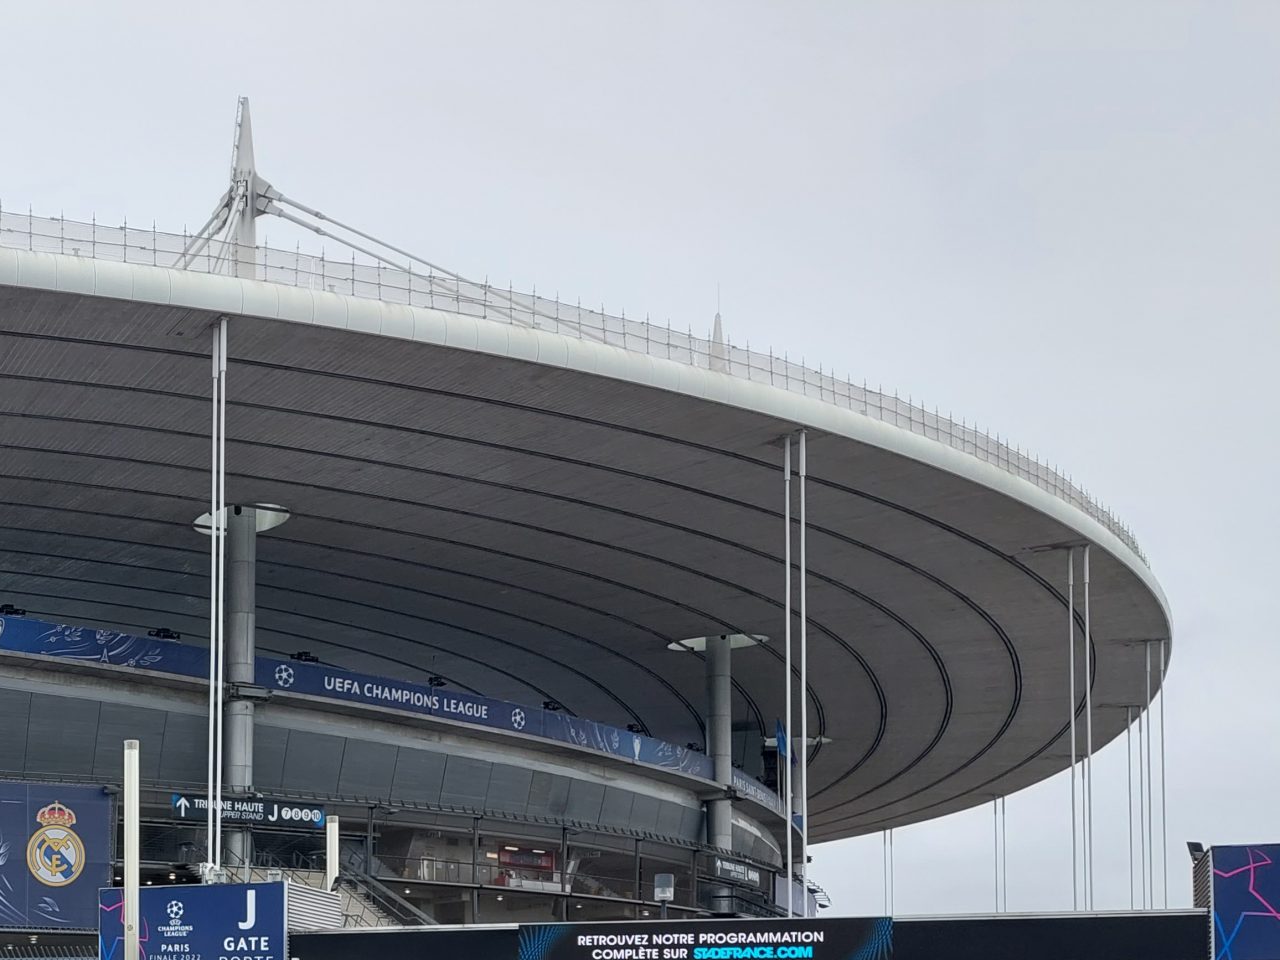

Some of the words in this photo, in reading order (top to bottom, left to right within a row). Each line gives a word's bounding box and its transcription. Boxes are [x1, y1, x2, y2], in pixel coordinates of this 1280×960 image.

[324, 676, 360, 695] UEFA
[364, 683, 439, 709] CHAMPIONS
[443, 698, 488, 719] LEAGUE
[194, 799, 232, 811] TRIUNE
[235, 801, 264, 813] HAUTE
[268, 804, 278, 821] J
[241, 811, 264, 820] STAND
[238, 889, 256, 930] J
[223, 936, 269, 951] GATE
[577, 935, 649, 946] RETROUVEZ
[652, 933, 695, 945] NOTRE
[699, 931, 824, 944] PROGRAMMATION
[161, 943, 190, 953] PARIS
[592, 946, 659, 960] COMPLÈTE
[663, 948, 688, 959] SUR
[693, 946, 813, 960] STADEFRANCE.COM
